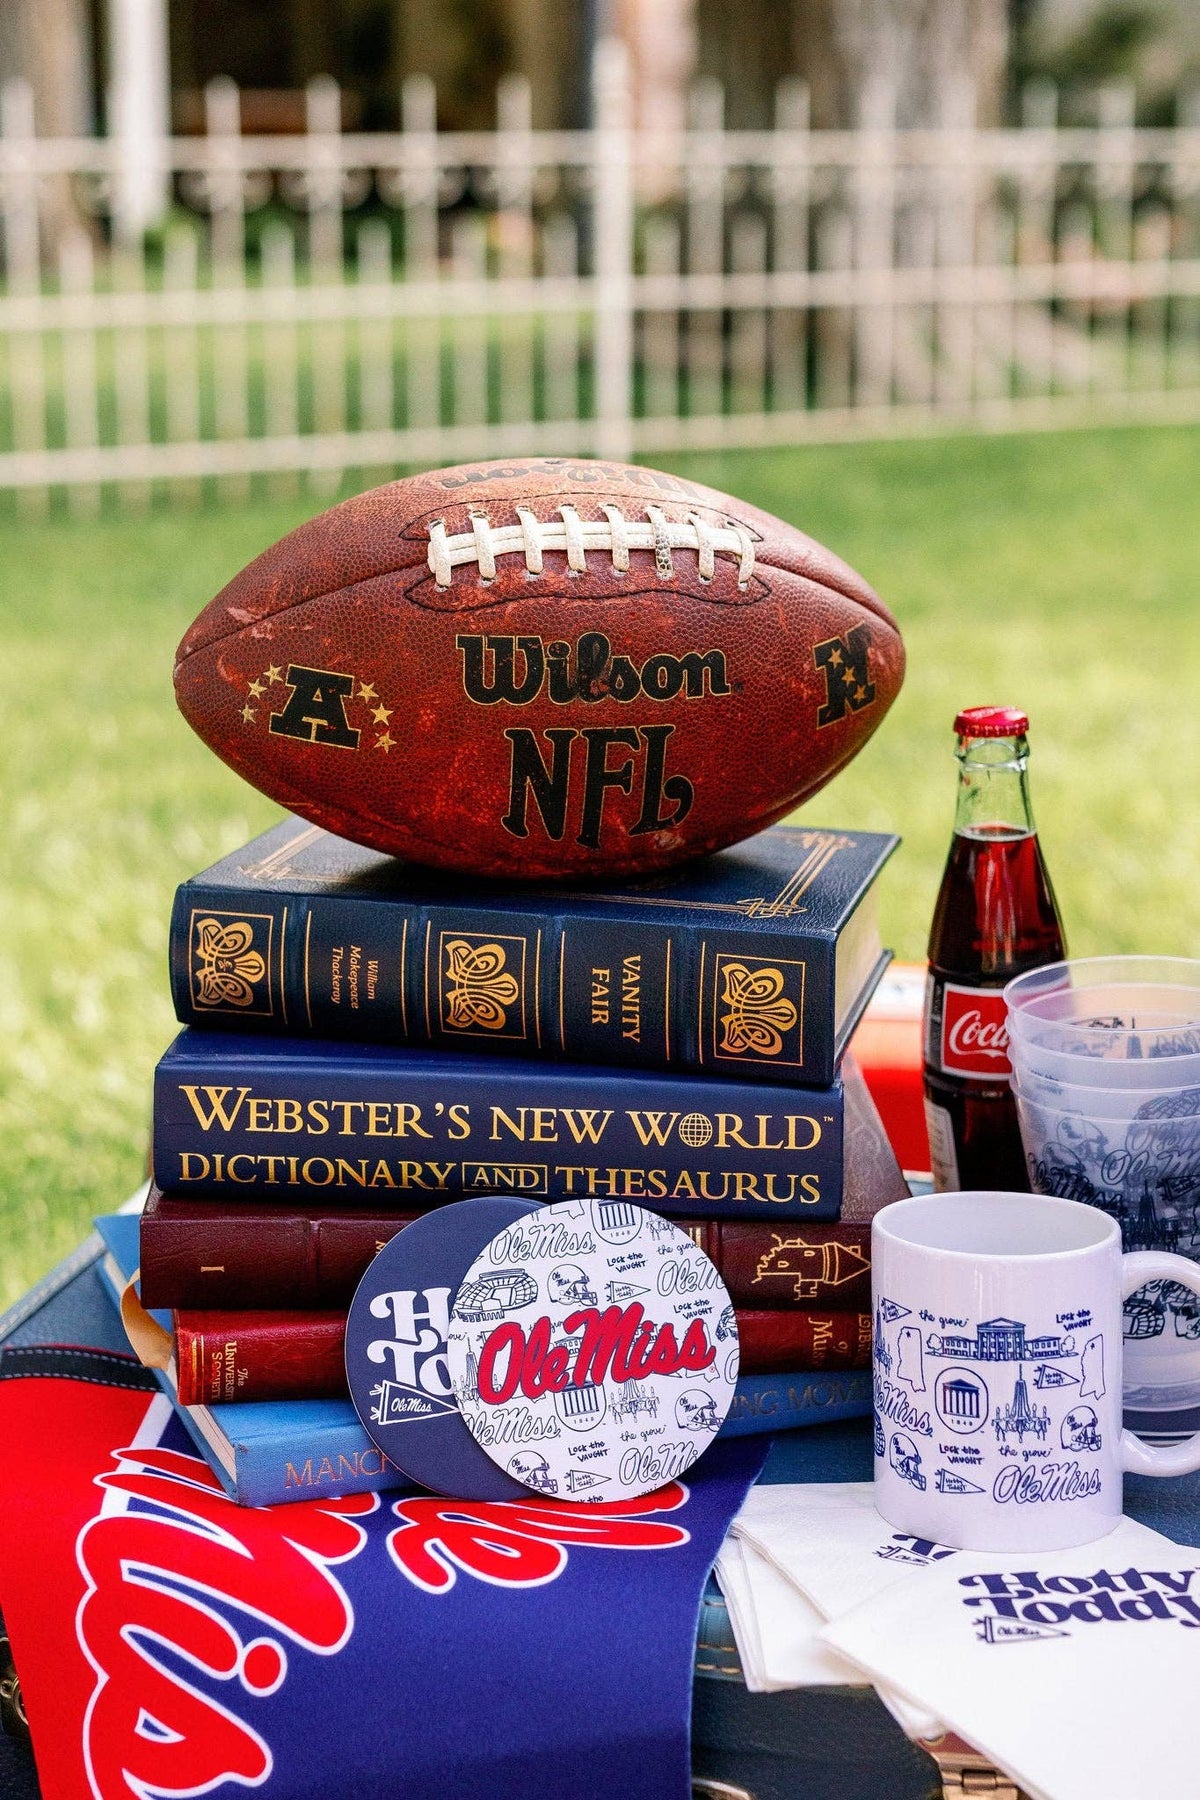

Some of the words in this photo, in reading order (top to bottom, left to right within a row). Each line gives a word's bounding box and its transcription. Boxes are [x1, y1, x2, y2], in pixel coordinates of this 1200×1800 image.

[455, 631, 734, 705] Wilson
[268, 663, 360, 750] A
[500, 724, 694, 849] NFL
[331, 947, 344, 1004] Thackeray
[348, 945, 362, 1009] Makepeace
[367, 960, 379, 999] William
[591, 967, 610, 1024] FAIR
[621, 955, 641, 1043] VANITY
[178, 1085, 472, 1140] WEBSTER'S
[489, 1106, 614, 1144] NEW
[178, 1153, 456, 1190] DICTIONARY
[471, 1166, 540, 1189] AND
[555, 1166, 820, 1203] THESAURUS
[489, 1227, 531, 1265] Ole
[528, 1223, 596, 1259] Miss
[656, 1244, 674, 1256] the
[616, 1260, 646, 1273] VAUGHT
[683, 1306, 713, 1320] VAUGHT
[918, 1309, 935, 1321] the
[939, 1316, 968, 1329] grove
[477, 1316, 570, 1405] Ole
[563, 1302, 716, 1386] Miss
[391, 1398, 408, 1412] Ole
[406, 1397, 433, 1413] Miss
[492, 1406, 561, 1443] Miss
[620, 1431, 637, 1442] the
[640, 1427, 665, 1442] grove
[998, 1445, 1017, 1457] the
[1022, 1448, 1052, 1462] grove
[577, 1449, 608, 1462] VAUGHT
[619, 1445, 660, 1485] Ole
[993, 1465, 1042, 1504] Ole
[1041, 1461, 1102, 1501] Miss
[958, 1568, 1195, 1595] Hotty
